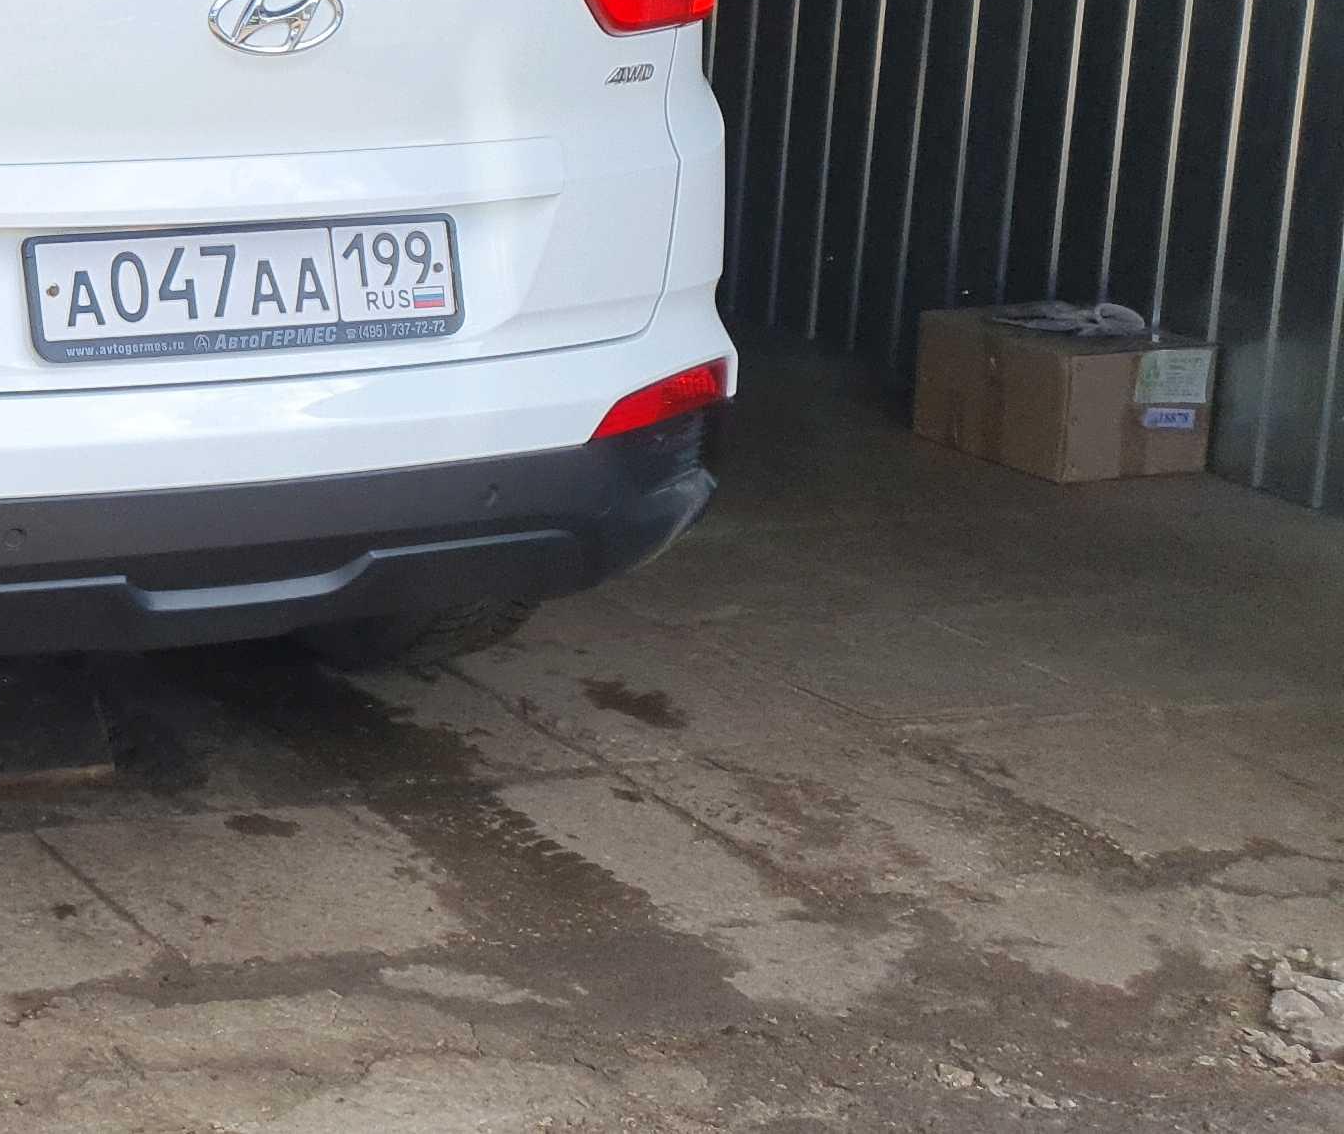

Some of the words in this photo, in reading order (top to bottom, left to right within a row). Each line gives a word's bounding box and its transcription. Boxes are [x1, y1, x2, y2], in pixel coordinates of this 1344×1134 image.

[343, 231, 431, 287] 199
[367, 289, 410, 310] RUS
[358, 323, 387, 339] (495)
[66, 341, 185, 357] www.avtogermes.ru
